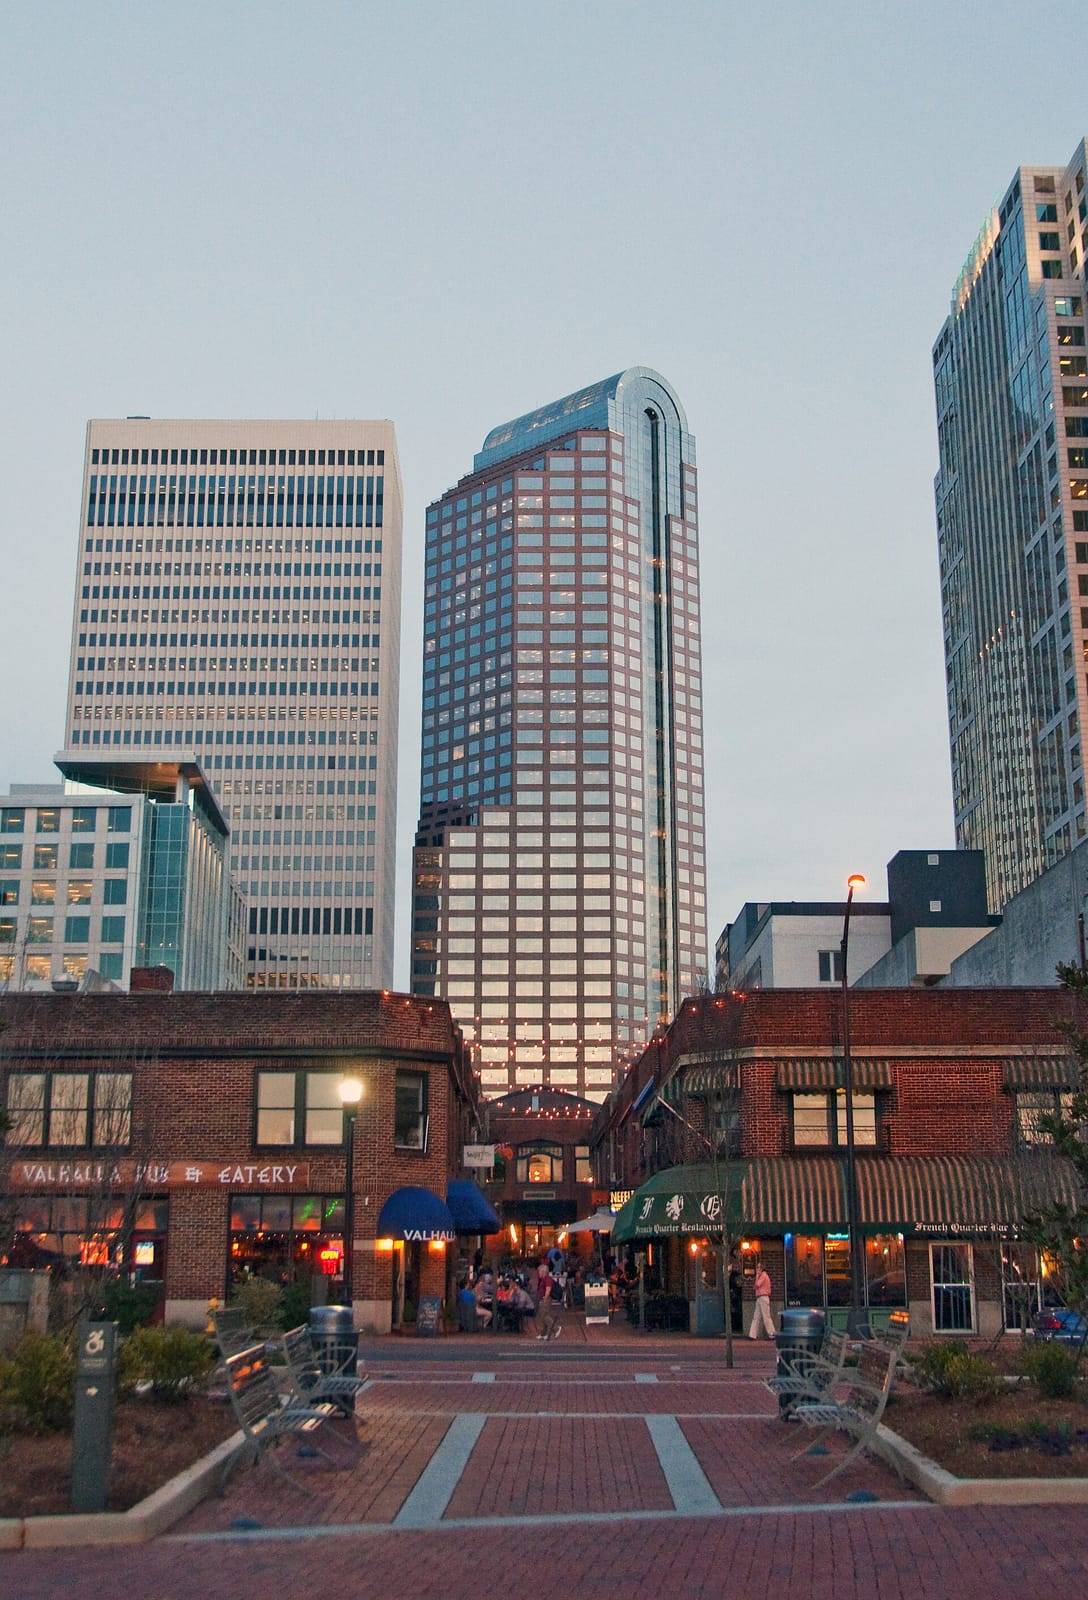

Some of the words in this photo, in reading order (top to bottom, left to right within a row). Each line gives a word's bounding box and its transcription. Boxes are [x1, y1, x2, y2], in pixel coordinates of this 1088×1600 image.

[23, 1165, 122, 1183] VALHALLA
[218, 1165, 298, 1184] EATERY
[653, 1224, 680, 1234] Quarter
[914, 1222, 948, 1233] French
[950, 1222, 988, 1233] Quarter
